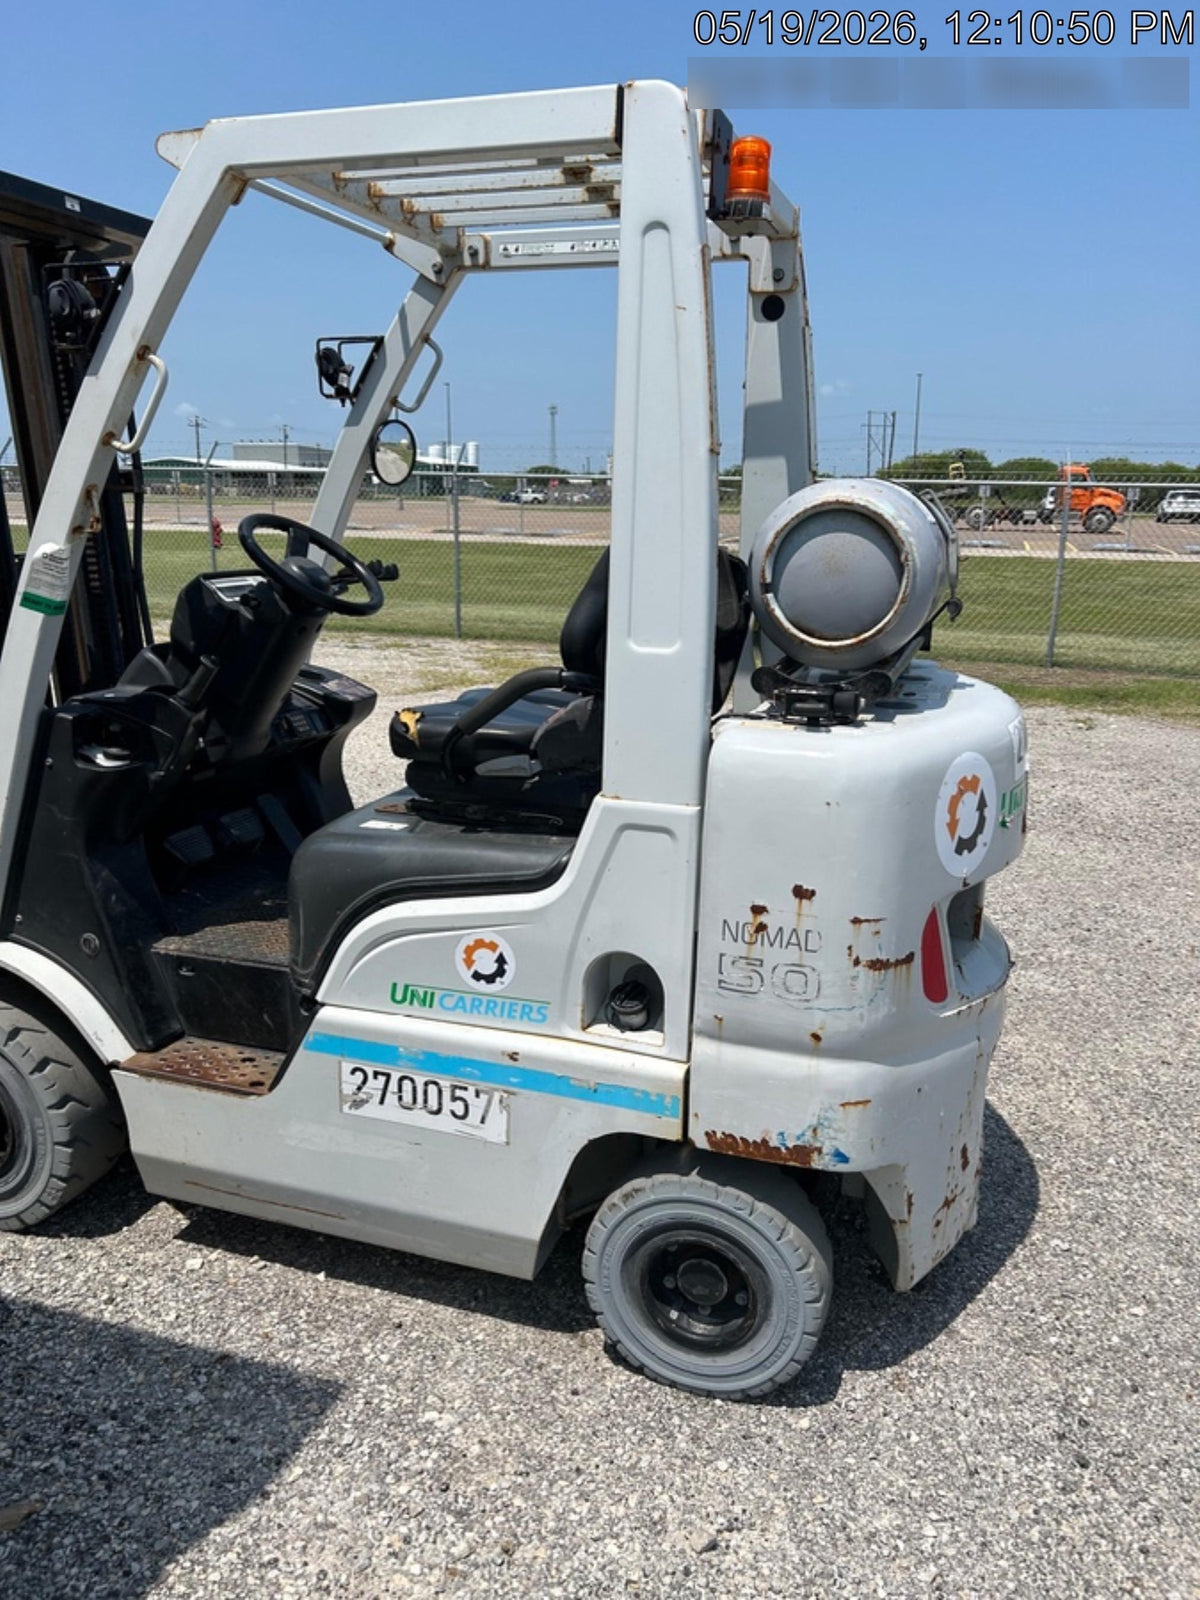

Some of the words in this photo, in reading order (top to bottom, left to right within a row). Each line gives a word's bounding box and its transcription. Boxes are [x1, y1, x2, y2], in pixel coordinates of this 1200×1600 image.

[721, 918, 823, 954] NOMAD
[718, 953, 821, 1003] 50
[349, 1066, 496, 1125] 270057
